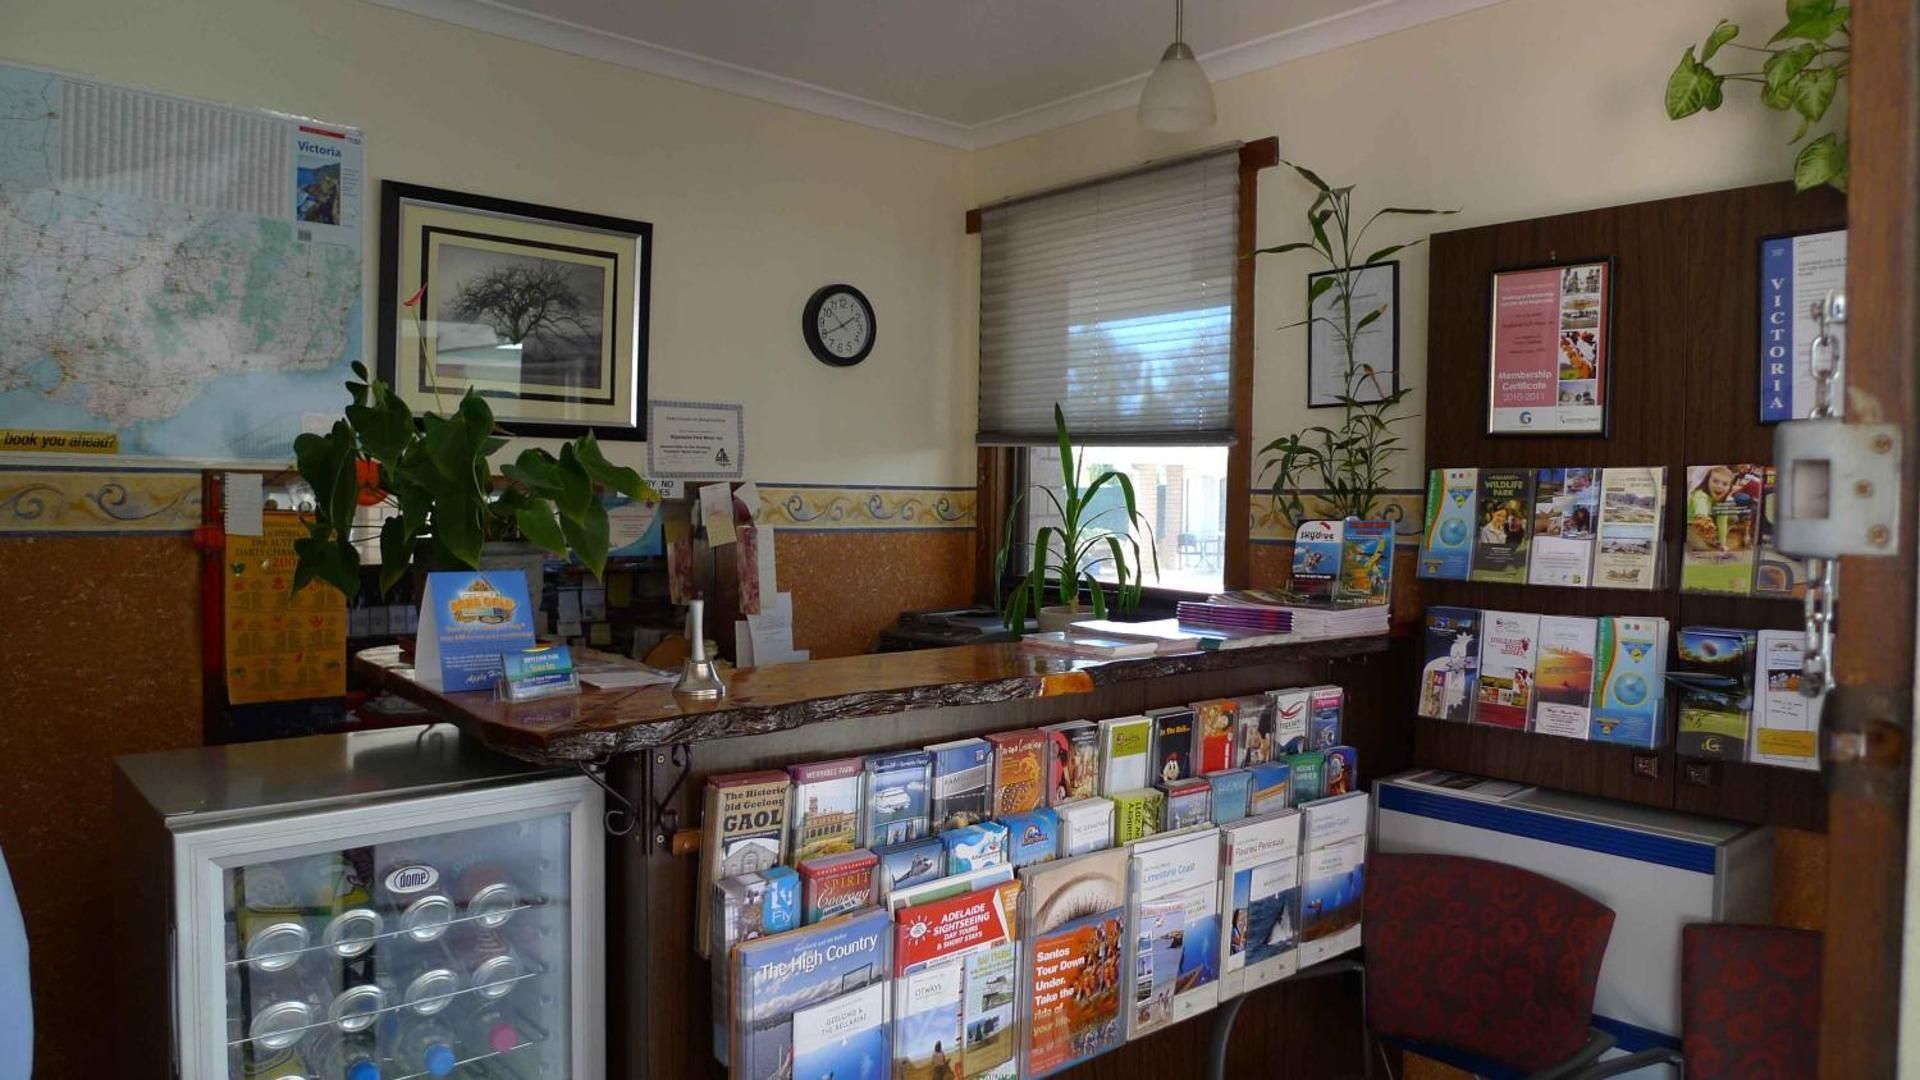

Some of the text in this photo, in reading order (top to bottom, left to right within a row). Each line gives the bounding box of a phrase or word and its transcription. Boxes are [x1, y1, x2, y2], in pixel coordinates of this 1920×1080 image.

[298, 140, 341, 157] Victoria
[1769, 278, 1785, 409] VICTORIA
[1498, 370, 1553, 381] Membership
[1502, 382, 1547, 391] Certificate
[4, 432, 37, 446] book
[40, 435, 66, 448] you
[1484, 480, 1523, 489] WILDLIFE
[725, 787, 786, 801] The Historic
[743, 798, 784, 810] Geelong
[723, 809, 782, 832] GAOL
[1178, 861, 1196, 874] Coast
[400, 872, 426, 888] dome
[823, 871, 871, 895] SPIRIT
[772, 910, 792, 924] Fly
[941, 903, 986, 924] ADELAIDE
[933, 912, 990, 936] SIGHTSEEING
[943, 936, 962, 949] SHORT
[964, 930, 983, 942] STAYS
[944, 925, 979, 940] DAY TOURS
[760, 962, 787, 981] The
[791, 950, 822, 973] High
[826, 934, 877, 961] Country
[1036, 947, 1070, 962] Santos
[1036, 956, 1085, 977] Tour Down
[1035, 976, 1066, 992] Under.
[1035, 987, 1074, 1006] Take the
[1034, 1002, 1064, 1020] ride of
[1033, 1022, 1053, 1037] your
